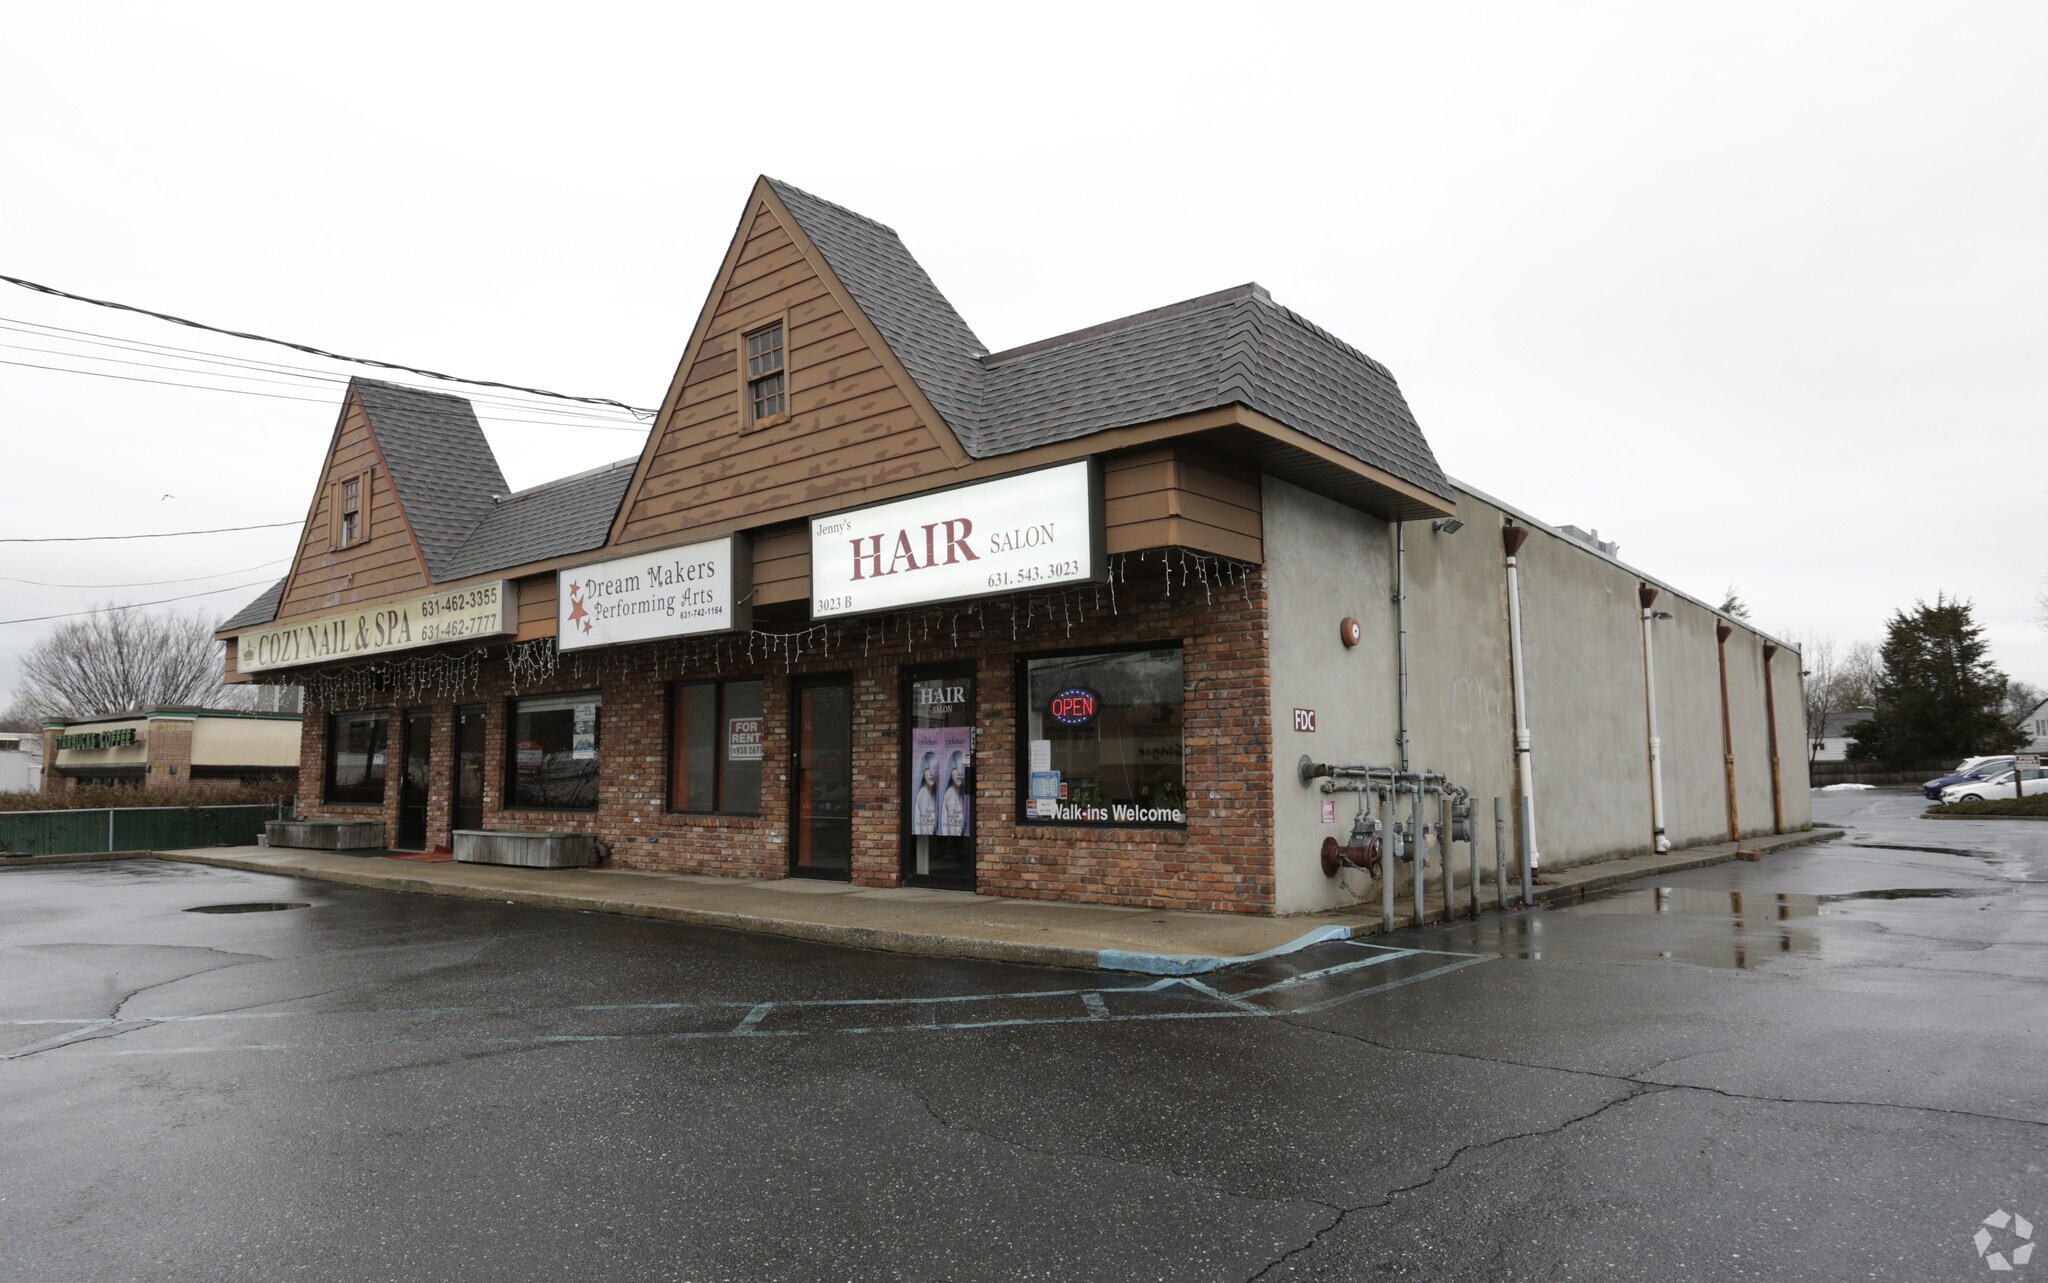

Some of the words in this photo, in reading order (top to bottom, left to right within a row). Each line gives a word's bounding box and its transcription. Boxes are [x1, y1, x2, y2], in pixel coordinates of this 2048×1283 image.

[817, 519, 851, 536] Jenny's
[849, 517, 980, 581] HAIR
[990, 523, 1055, 554] SALON
[585, 575, 640, 599] Dream
[647, 560, 715, 588] Makers
[421, 587, 497, 617] 631-462-3355
[594, 594, 676, 621] Performing
[681, 587, 713, 607] Arts
[817, 597, 841, 613] 3023
[844, 595, 852, 608] B
[421, 613, 497, 641] 631-462-7777
[258, 627, 304, 666] COZY
[306, 619, 350, 658] NAIL
[355, 615, 369, 651] &
[374, 608, 412, 648] SPA
[920, 686, 966, 705] HAIR
[932, 705, 953, 714] SALON
[1052, 697, 1093, 717] OPEN
[735, 721, 758, 733] FOR
[1295, 709, 1314, 731] FDC
[100, 728, 133, 747] COFFEE
[731, 732, 762, 744] RENT
[1050, 803, 1108, 820] Walk-ins
[1112, 804, 1181, 821] Welcome
